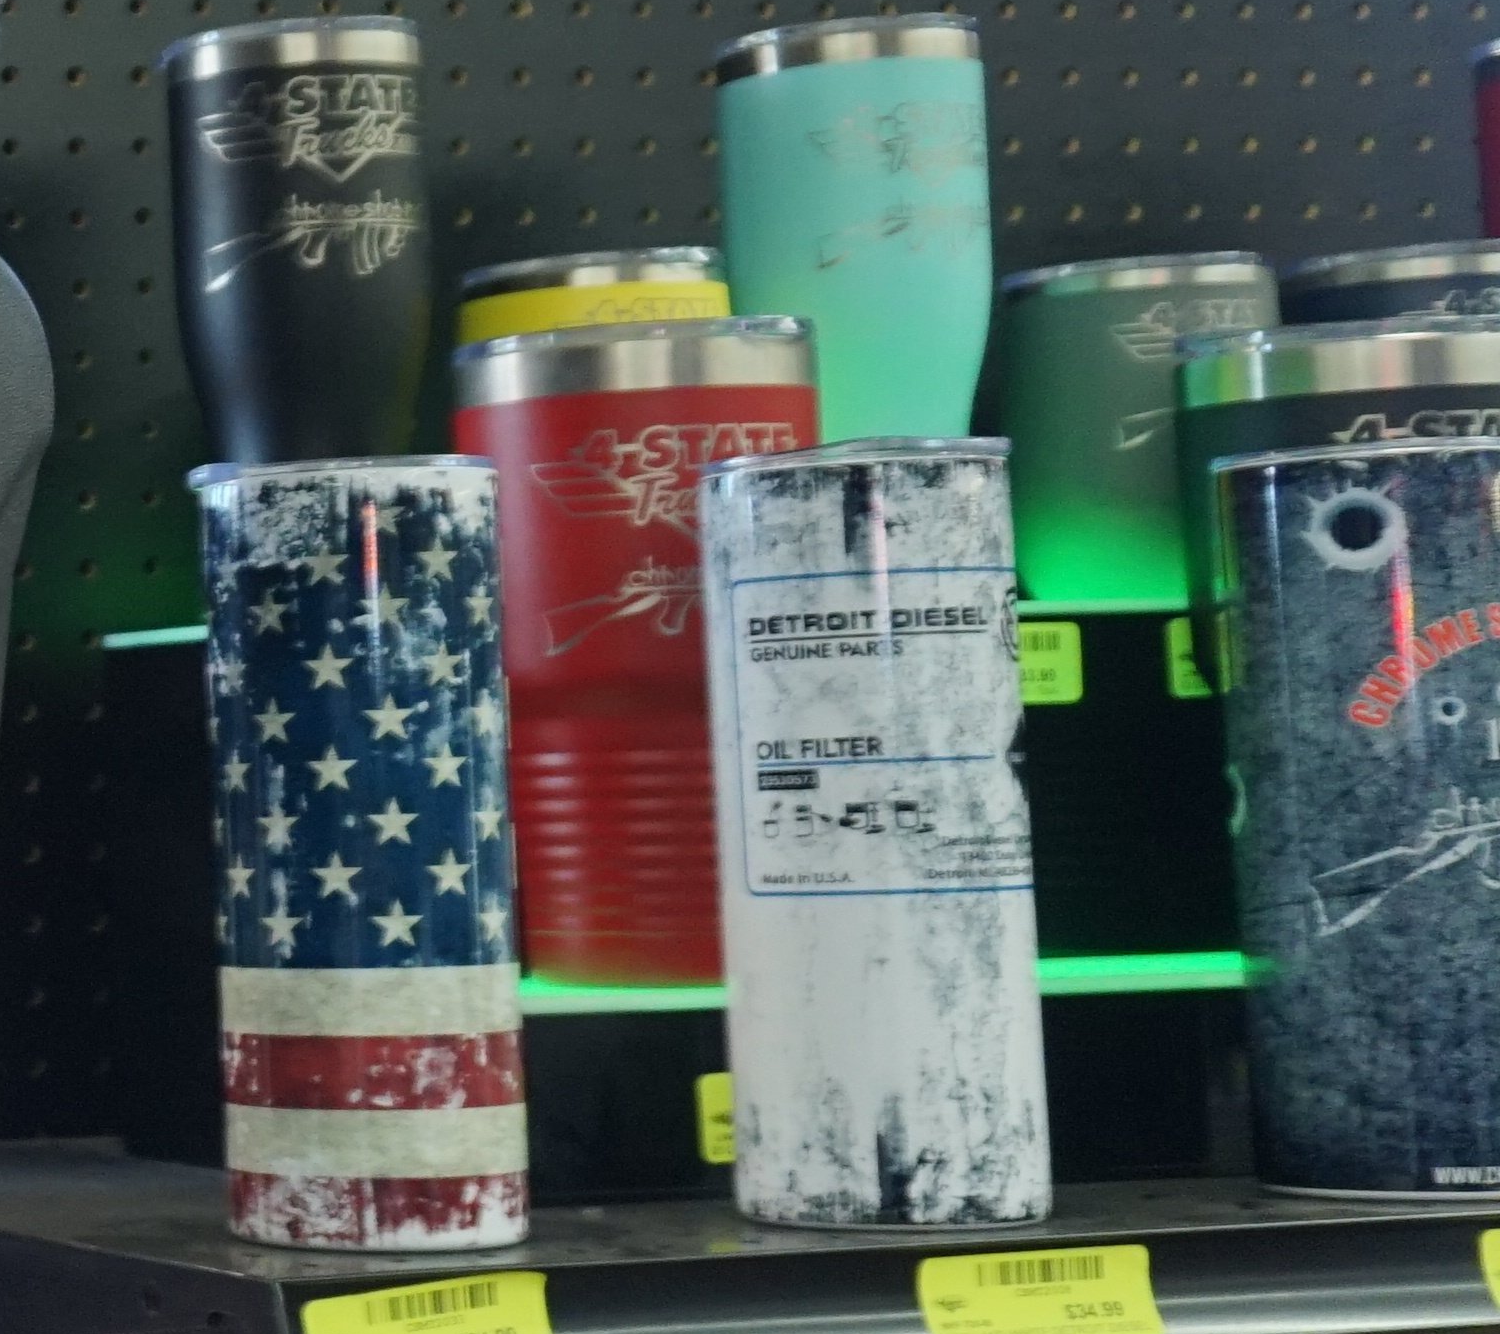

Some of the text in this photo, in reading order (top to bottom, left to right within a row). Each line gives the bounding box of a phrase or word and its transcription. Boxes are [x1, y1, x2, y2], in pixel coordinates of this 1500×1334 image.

[748, 606, 988, 636] DETROIT DIESEL
[751, 642, 833, 663] GENUINE
[757, 736, 884, 760] OIL FILTER
[763, 874, 794, 884] Made
[1065, 1301, 1125, 1319] $34.99
